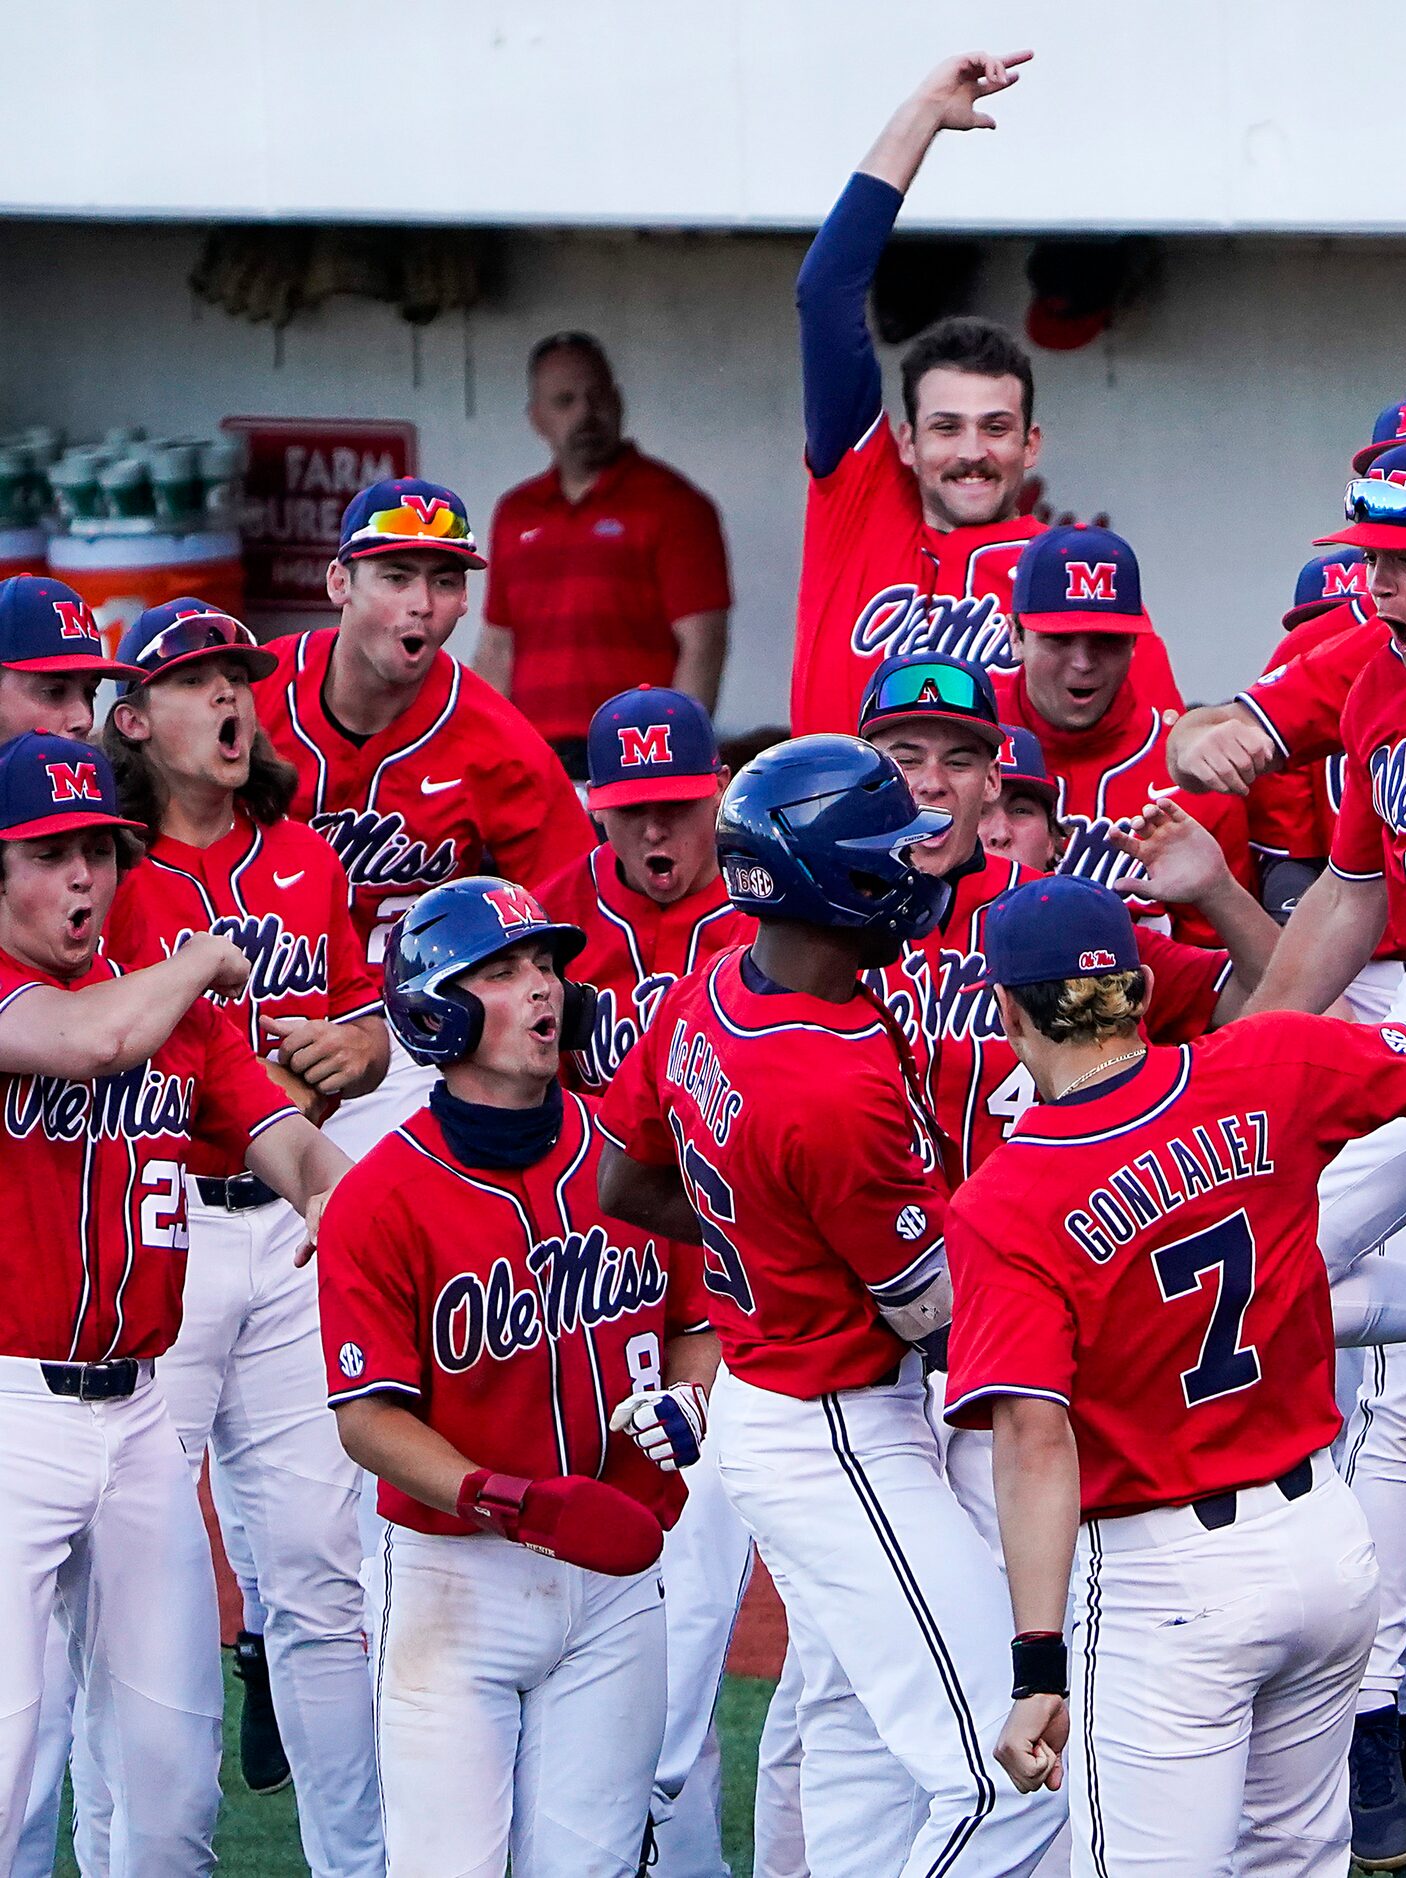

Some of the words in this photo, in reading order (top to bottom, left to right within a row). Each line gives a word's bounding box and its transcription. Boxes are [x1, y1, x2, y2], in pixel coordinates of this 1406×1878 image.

[285, 445, 396, 492] FARM
[1066, 562, 1117, 600] M
[1322, 562, 1370, 597] M
[52, 601, 101, 642] M
[619, 725, 671, 767] M
[46, 762, 102, 802] M
[309, 808, 459, 887] Miss
[749, 866, 773, 898] SEC
[482, 886, 549, 928] M
[1079, 952, 1095, 970] Ole
[1095, 949, 1117, 969] Miss
[666, 1018, 743, 1148] McCANTS
[1065, 1110, 1275, 1266] GONZALEZ
[895, 1204, 927, 1240] SEC
[432, 1256, 543, 1374] Ole
[526, 1224, 669, 1340] Miss
[1150, 1206, 1263, 1409] 7
[338, 1341, 366, 1379] SEC
